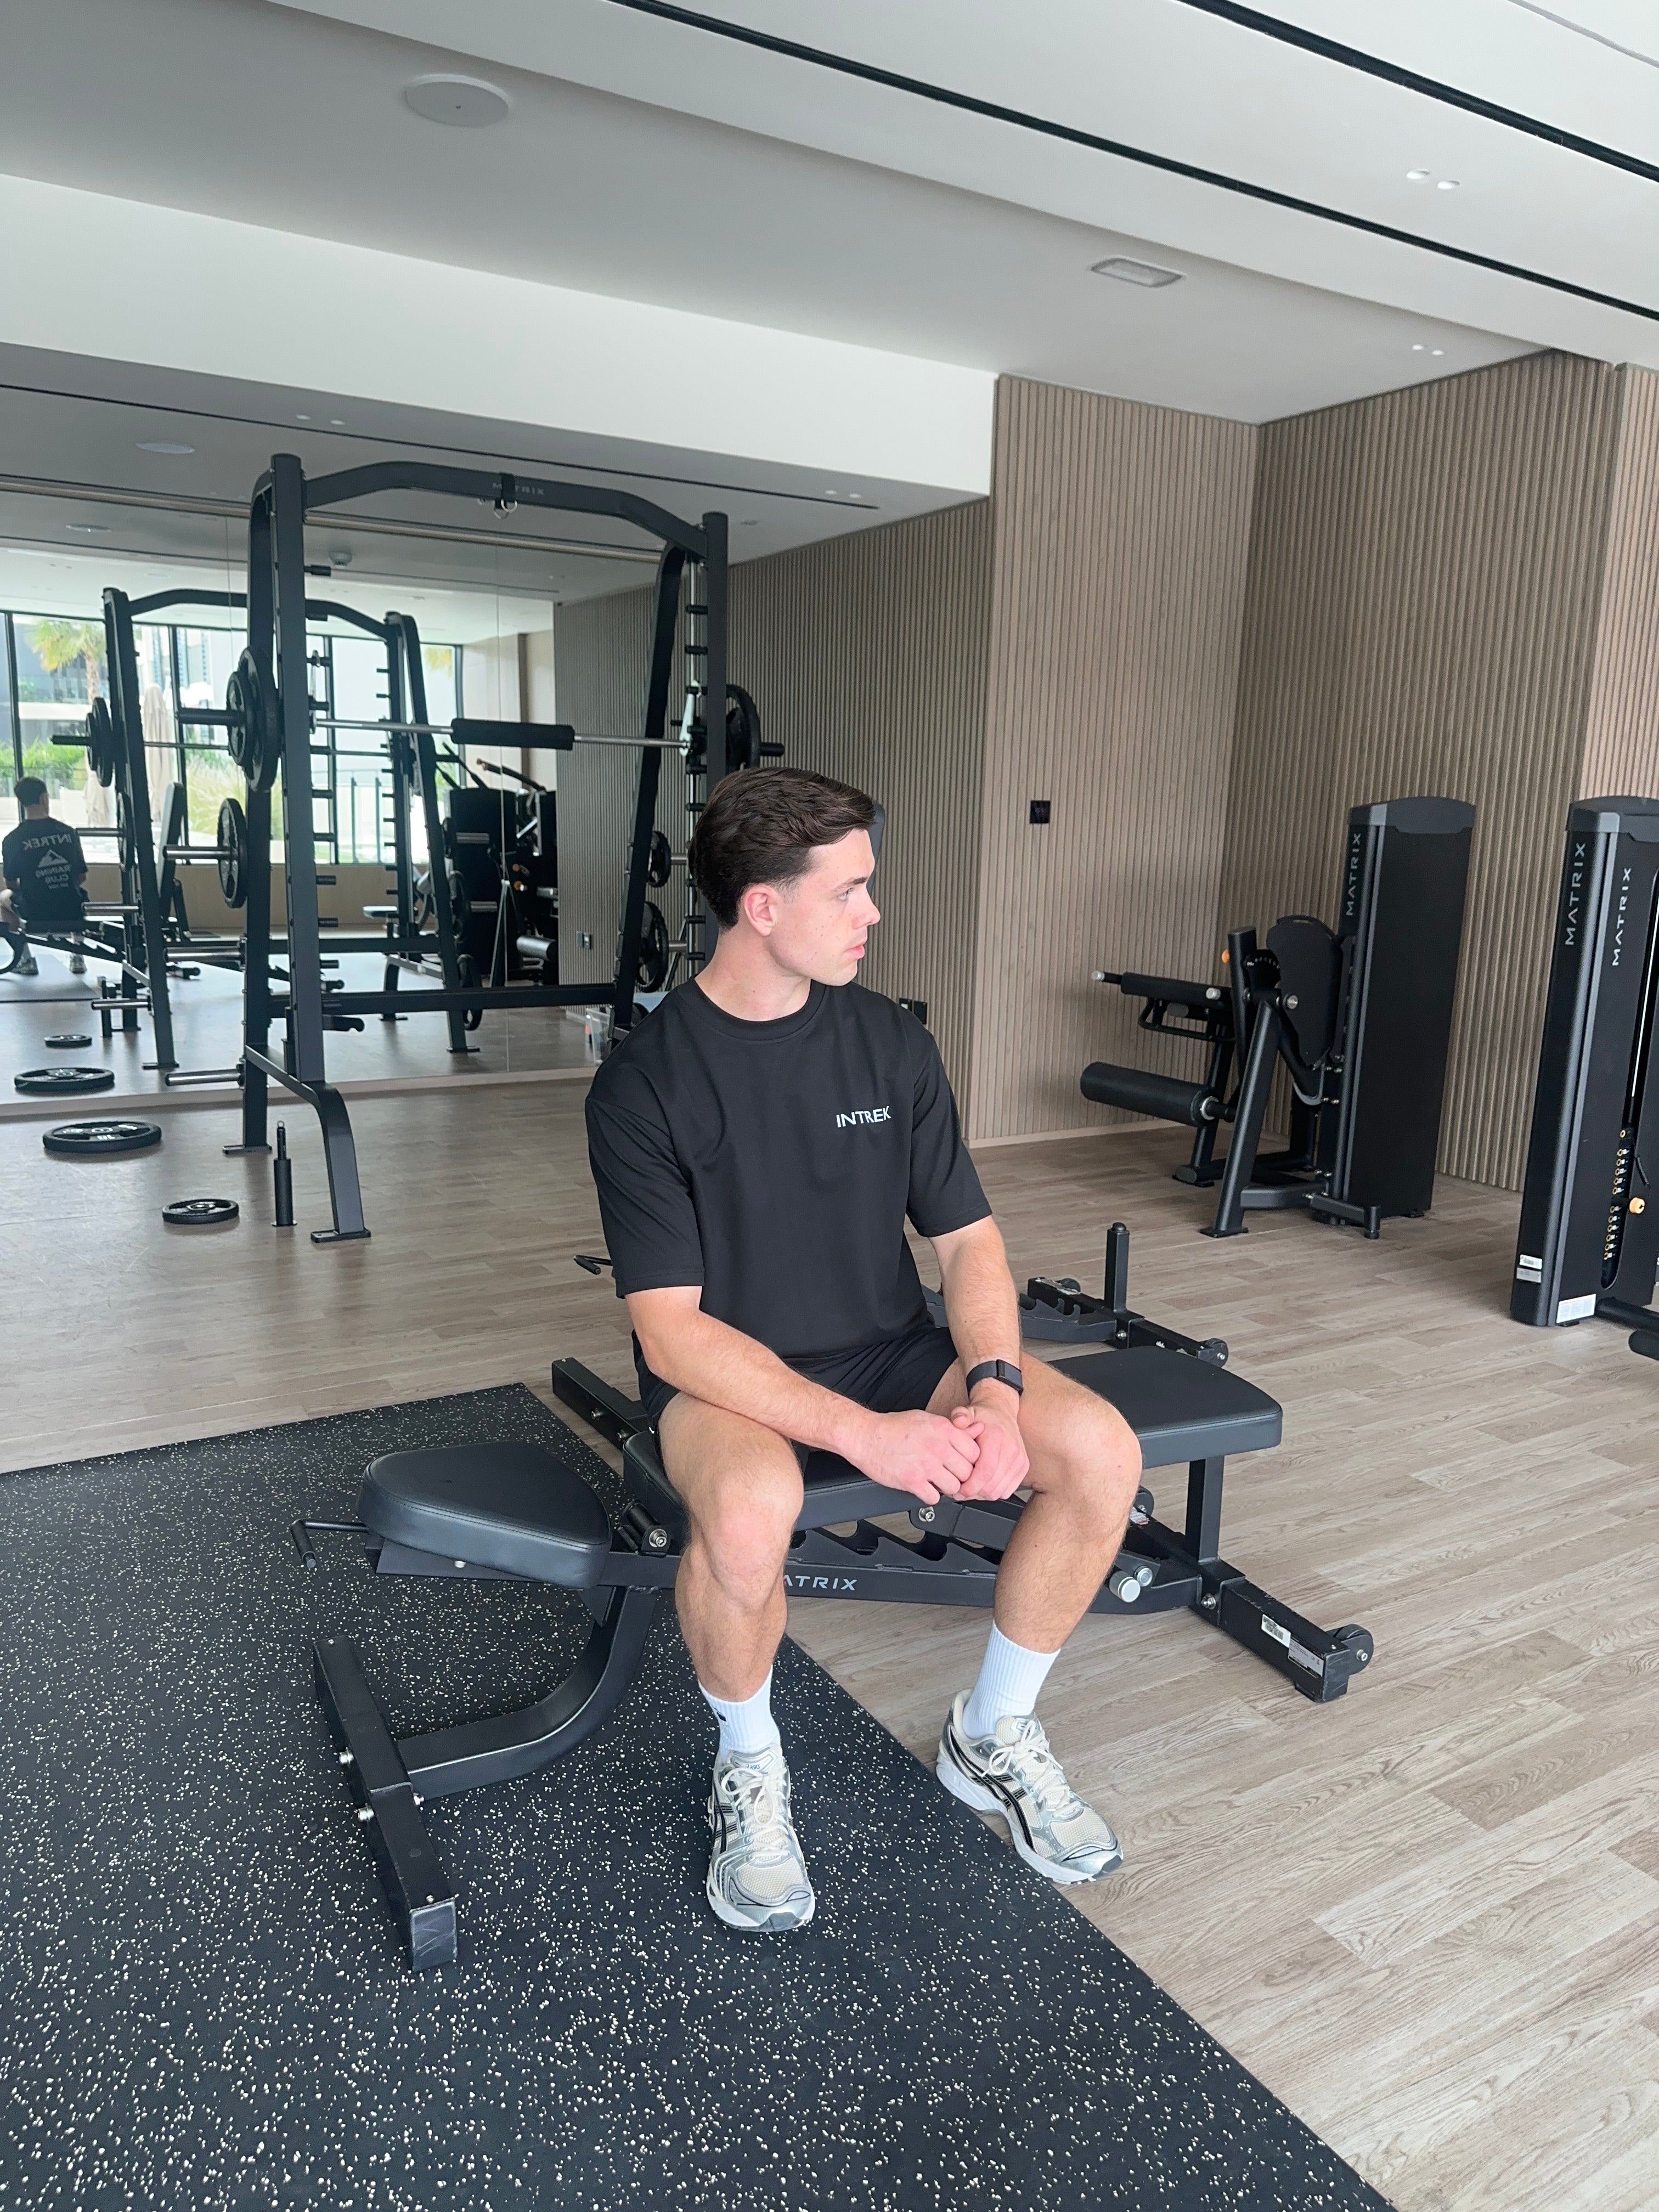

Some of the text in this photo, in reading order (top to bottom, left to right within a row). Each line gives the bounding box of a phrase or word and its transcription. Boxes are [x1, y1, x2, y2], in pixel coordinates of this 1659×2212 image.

[493, 482, 544, 495] MTRIX
[1346, 833, 1361, 916] MATRIX
[1565, 842, 1586, 945] MATRIX
[1612, 867, 1632, 966] MATRIX
[836, 1105, 891, 1128] INTREK
[783, 1574, 857, 1591] ATRIX
